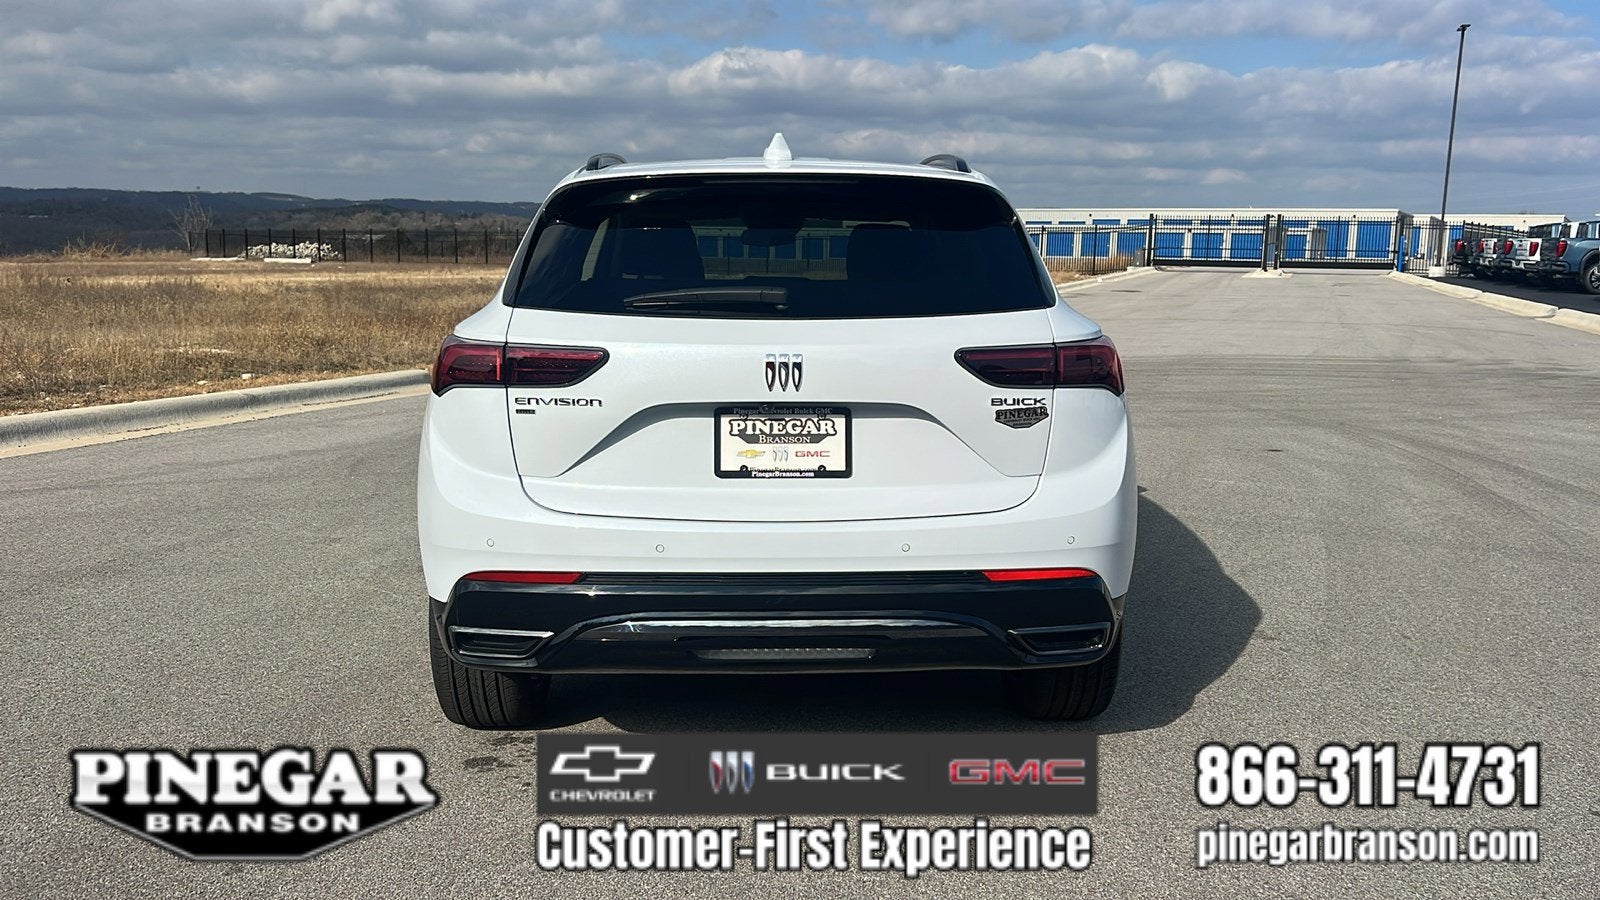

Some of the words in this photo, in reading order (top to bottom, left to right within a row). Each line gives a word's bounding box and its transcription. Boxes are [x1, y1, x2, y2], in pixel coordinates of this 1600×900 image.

[514, 397, 603, 407] ENVISION
[991, 397, 1047, 406] BUICK
[996, 406, 1048, 420] PINEGAR
[730, 419, 837, 435] PINEGAR
[758, 435, 811, 444] BRANSON
[795, 450, 830, 458] GMC
